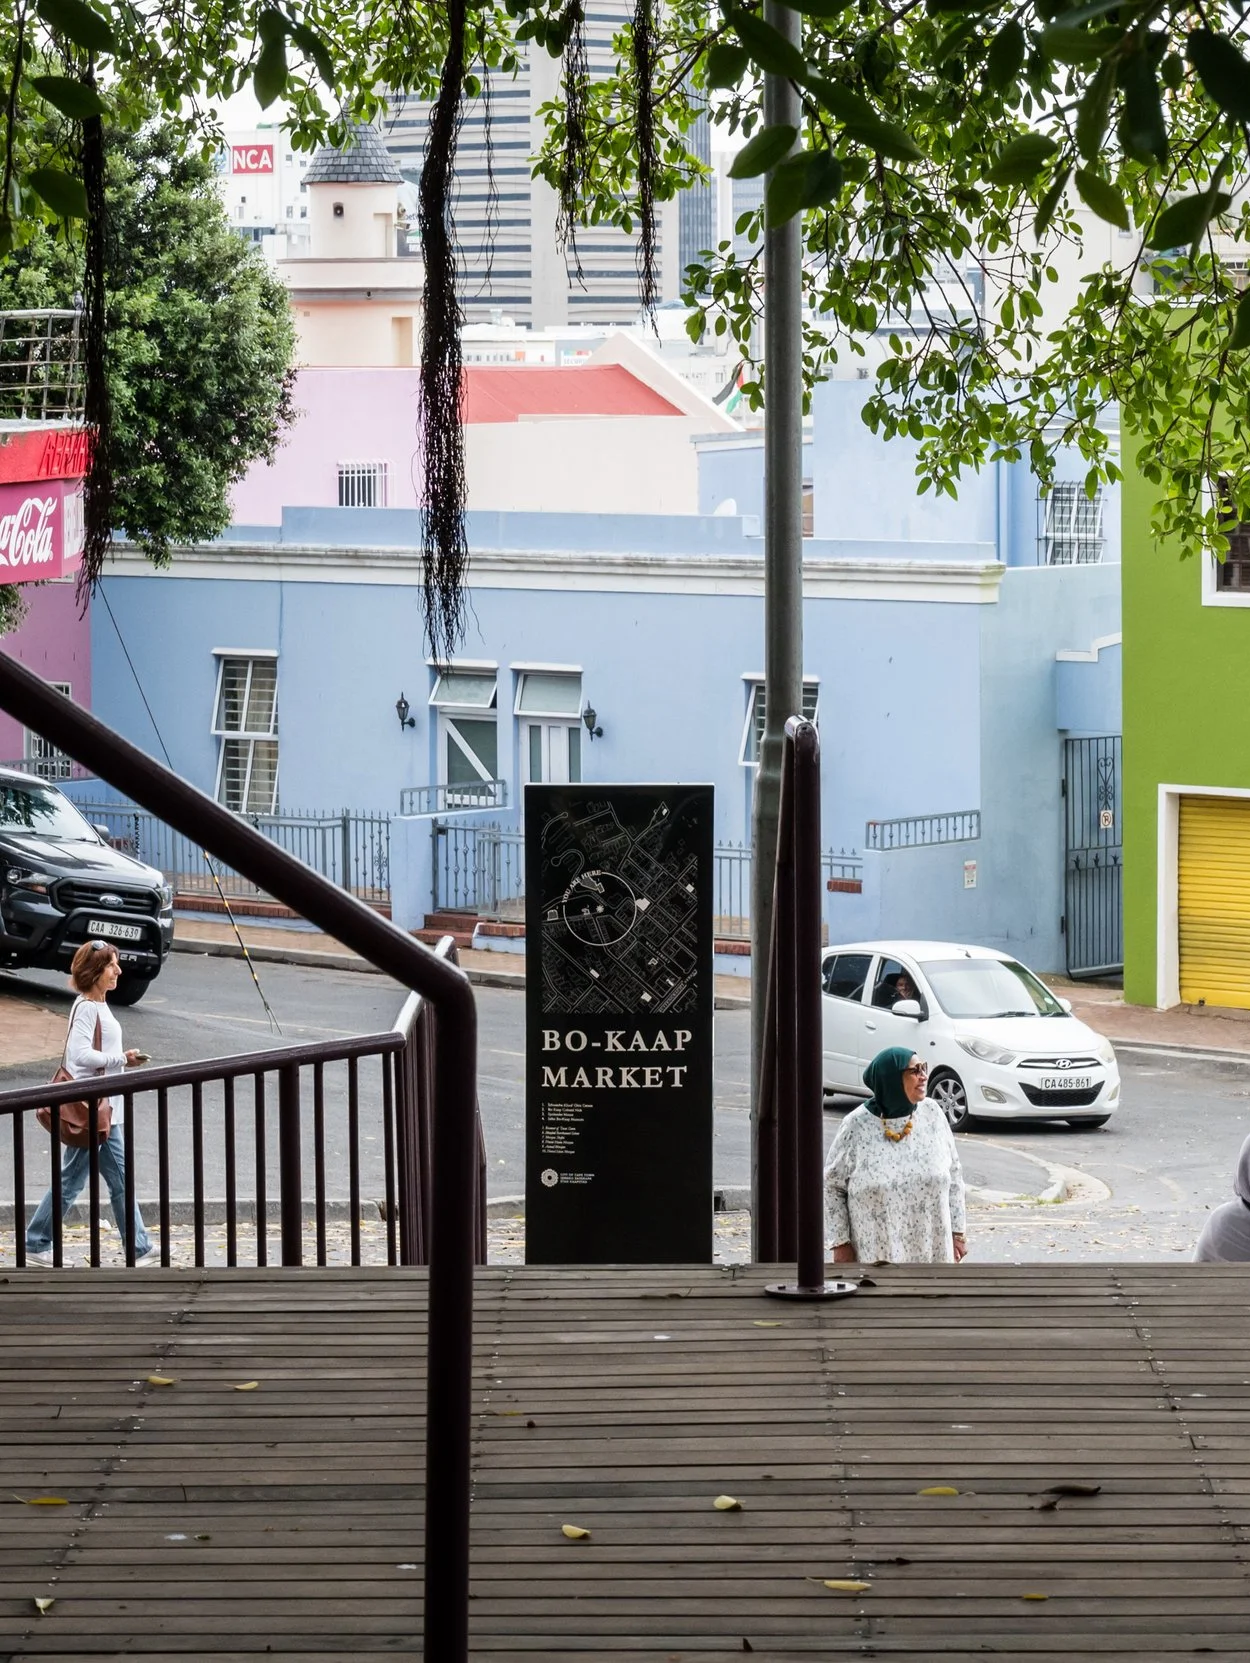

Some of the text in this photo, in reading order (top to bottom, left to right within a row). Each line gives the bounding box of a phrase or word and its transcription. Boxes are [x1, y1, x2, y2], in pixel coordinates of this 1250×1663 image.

[233, 149, 272, 169] NCA
[581, 870, 602, 880] HERE
[90, 922, 104, 933] CAA
[542, 1029, 692, 1052] BO-KAAP
[541, 1065, 687, 1088] MARKET
[1044, 1078, 1057, 1088] CA
